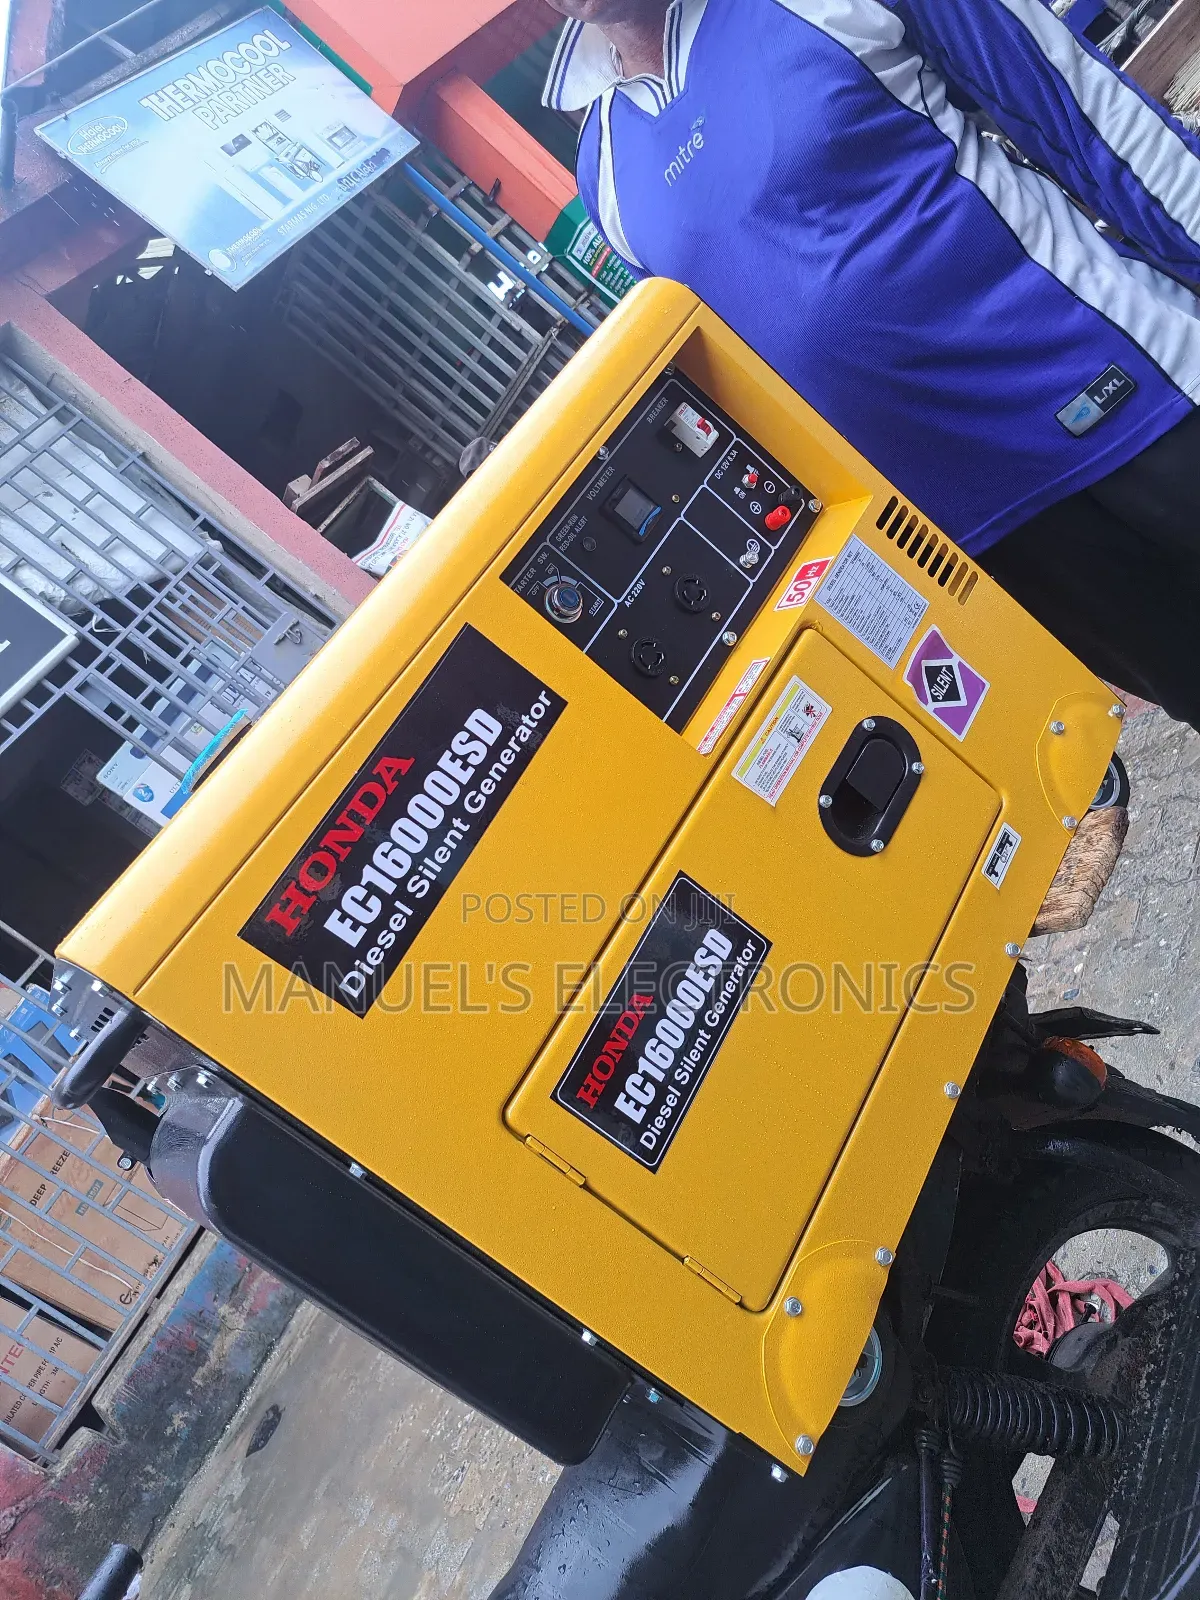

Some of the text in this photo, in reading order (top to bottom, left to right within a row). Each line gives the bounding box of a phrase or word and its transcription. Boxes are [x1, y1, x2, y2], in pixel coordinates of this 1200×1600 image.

[138, 26, 292, 123] THERMOCOOL
[193, 60, 296, 131] PARTNER
[77, 123, 125, 153] THERMOCOOL
[663, 132, 705, 187] mitre
[277, 209, 307, 235] STARMAS
[1094, 377, 1126, 405] L/XL
[645, 396, 669, 424] BREAKER
[586, 466, 616, 502] VOLTMETER
[714, 469, 724, 479] DC
[720, 459, 730, 471] 12V
[572, 514, 589, 534] ALERT
[513, 549, 550, 596] TARTER SW.
[785, 566, 819, 603] 50 Hz
[587, 596, 603, 616] START
[623, 578, 647, 608] AC 220V
[931, 665, 955, 700] SILENT
[764, 716, 779, 736] CAUTION
[103, 761, 118, 779] SONY
[265, 753, 416, 938] HONDA
[323, 707, 504, 949] EC16000ESD
[338, 689, 552, 999] Diesel Silent Generator
[613, 928, 733, 1124] EC16000ESD
[575, 992, 654, 1109] HONDA
[639, 938, 757, 1151] Diesel Silent Generator
[29, 1183, 48, 1206] DEEP
[33, 1364, 45, 1379] PIPE
[53, 1336, 62, 1347] A/C
